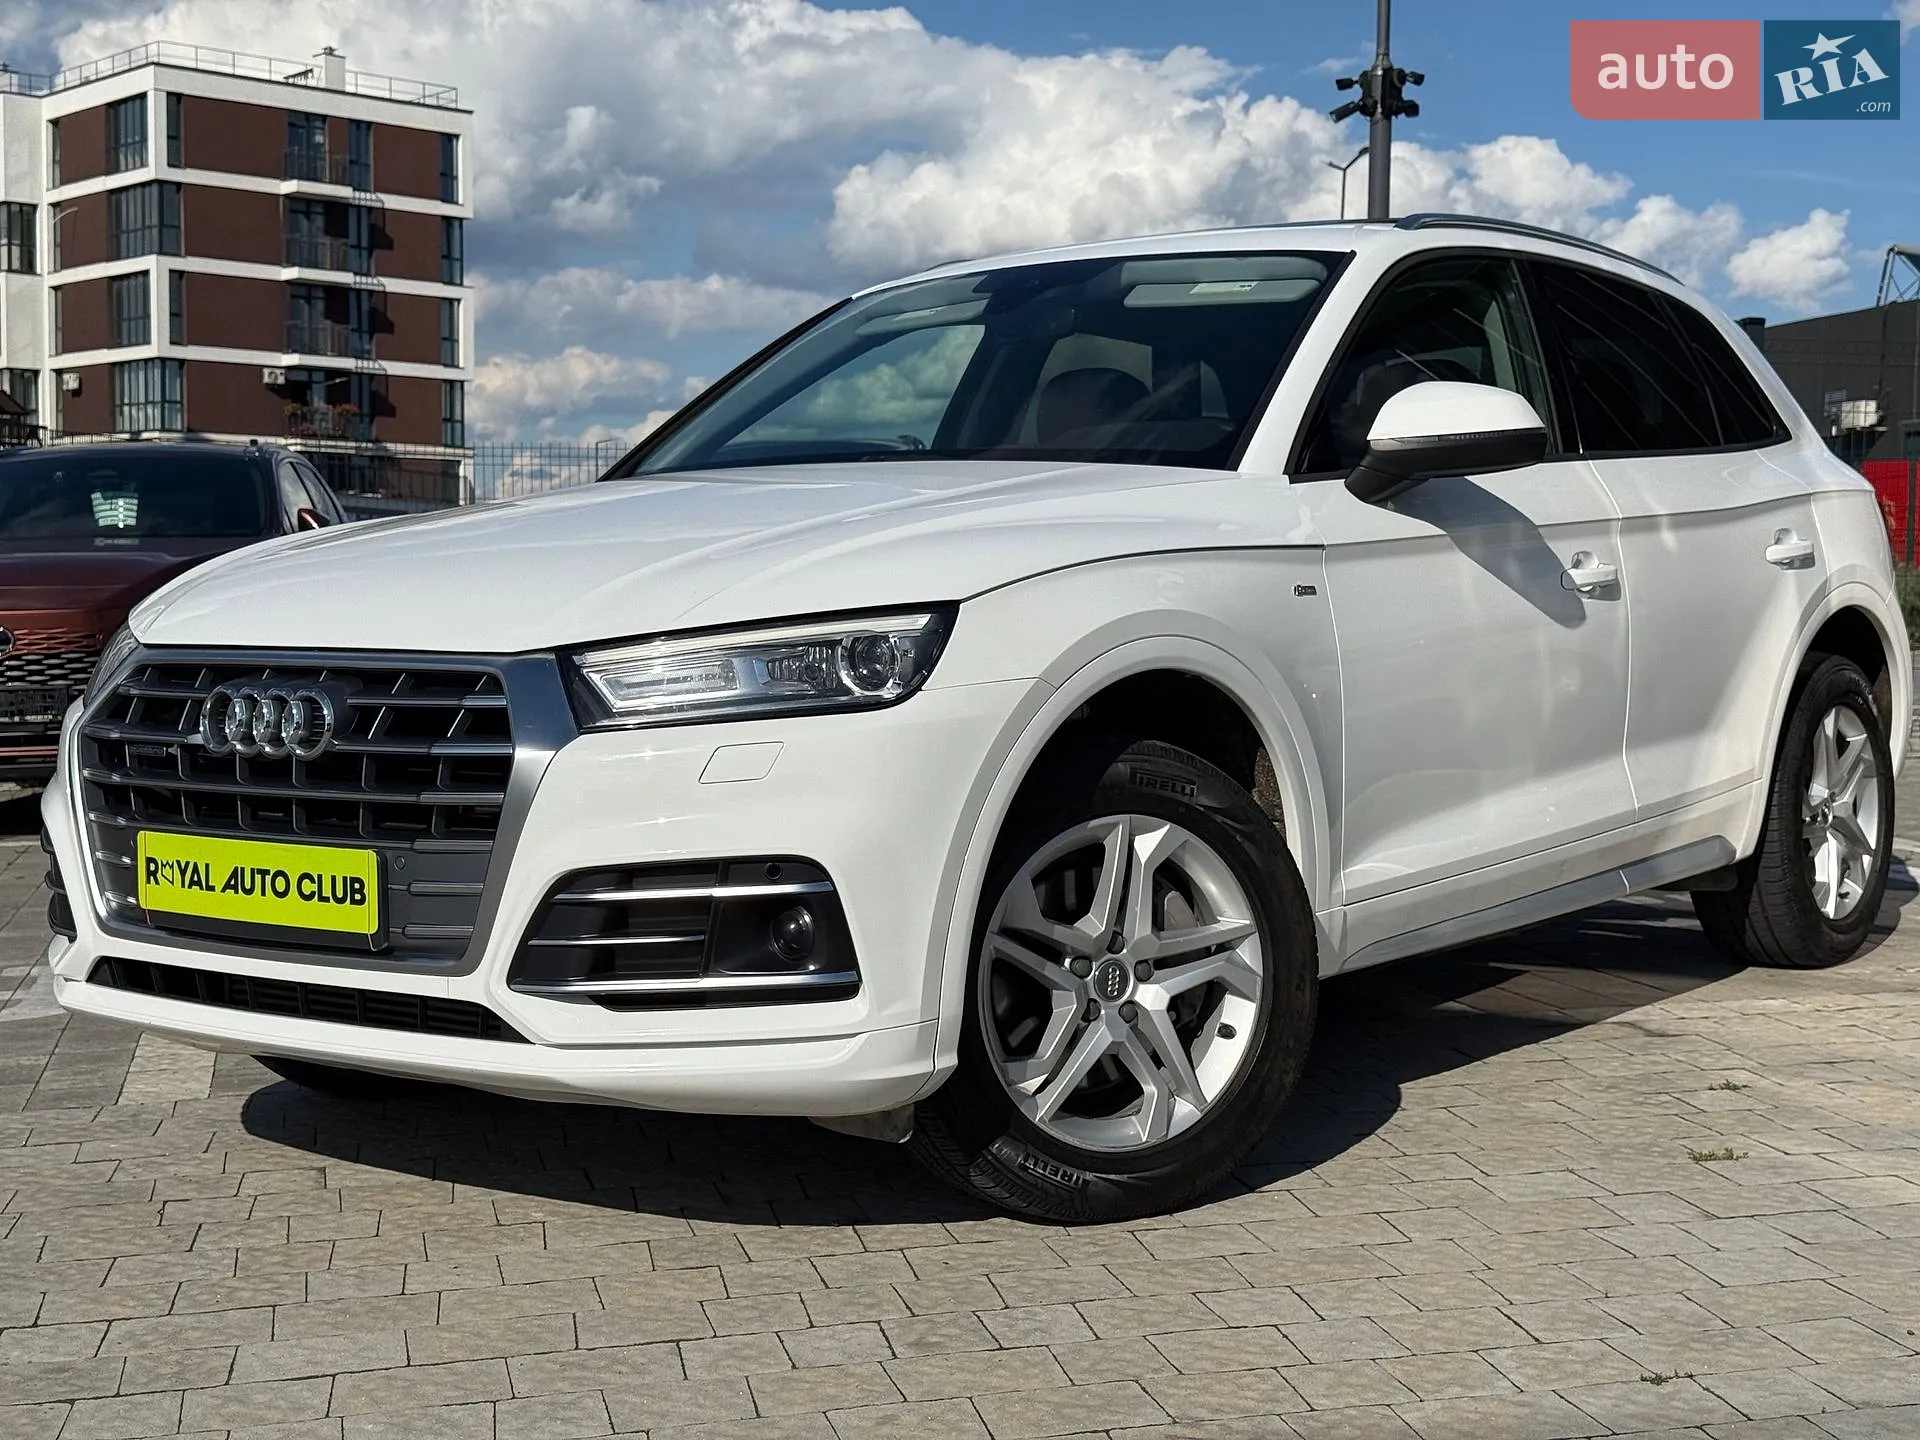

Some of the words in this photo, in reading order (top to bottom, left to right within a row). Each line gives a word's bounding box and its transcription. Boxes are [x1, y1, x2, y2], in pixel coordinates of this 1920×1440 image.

[1129, 766, 1197, 799] PIRELLI
[220, 865, 291, 899] AUTO
[297, 871, 367, 906] CLUB
